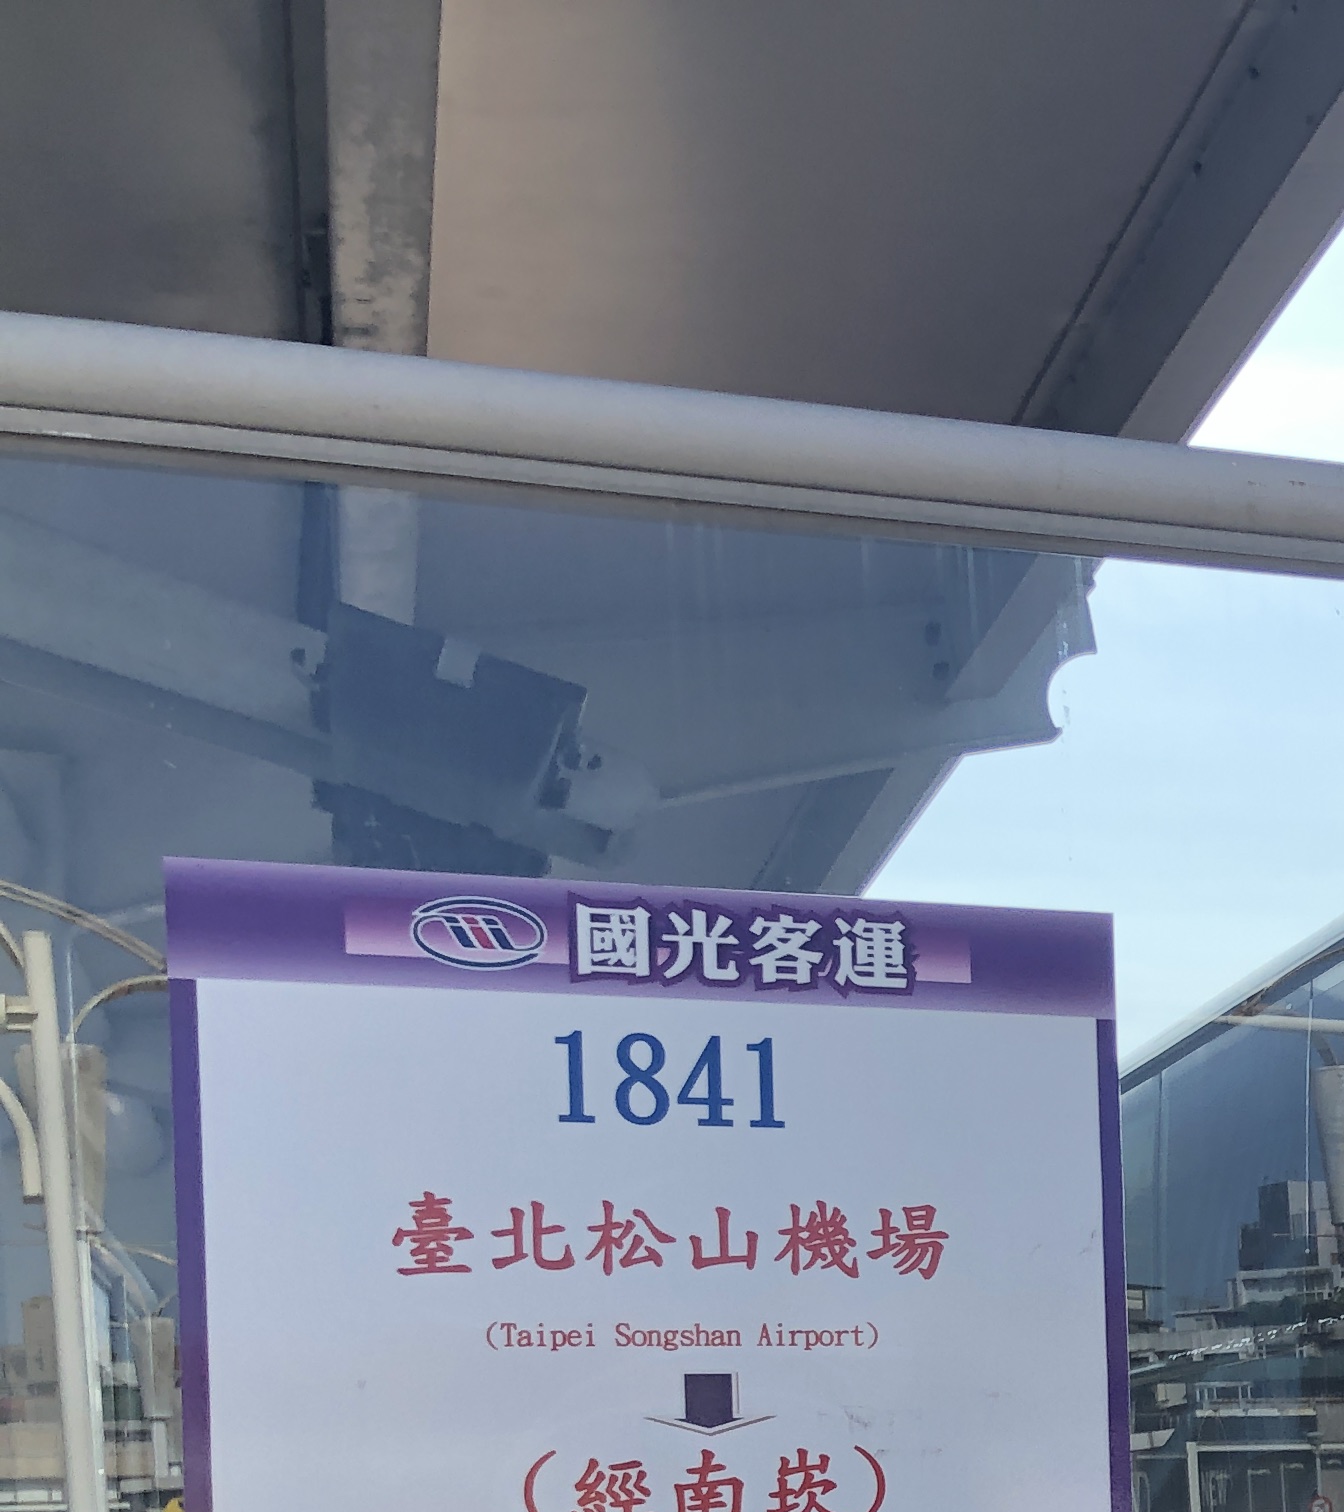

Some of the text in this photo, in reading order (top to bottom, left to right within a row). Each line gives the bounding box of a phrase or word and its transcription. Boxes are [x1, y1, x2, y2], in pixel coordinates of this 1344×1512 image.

[575, 901, 908, 989] 國光客運
[553, 1029, 786, 1129] 1841
[391, 1192, 950, 1281] 臺北松山機場
[484, 1321, 881, 1353] (Taipei Songshan Airport)
